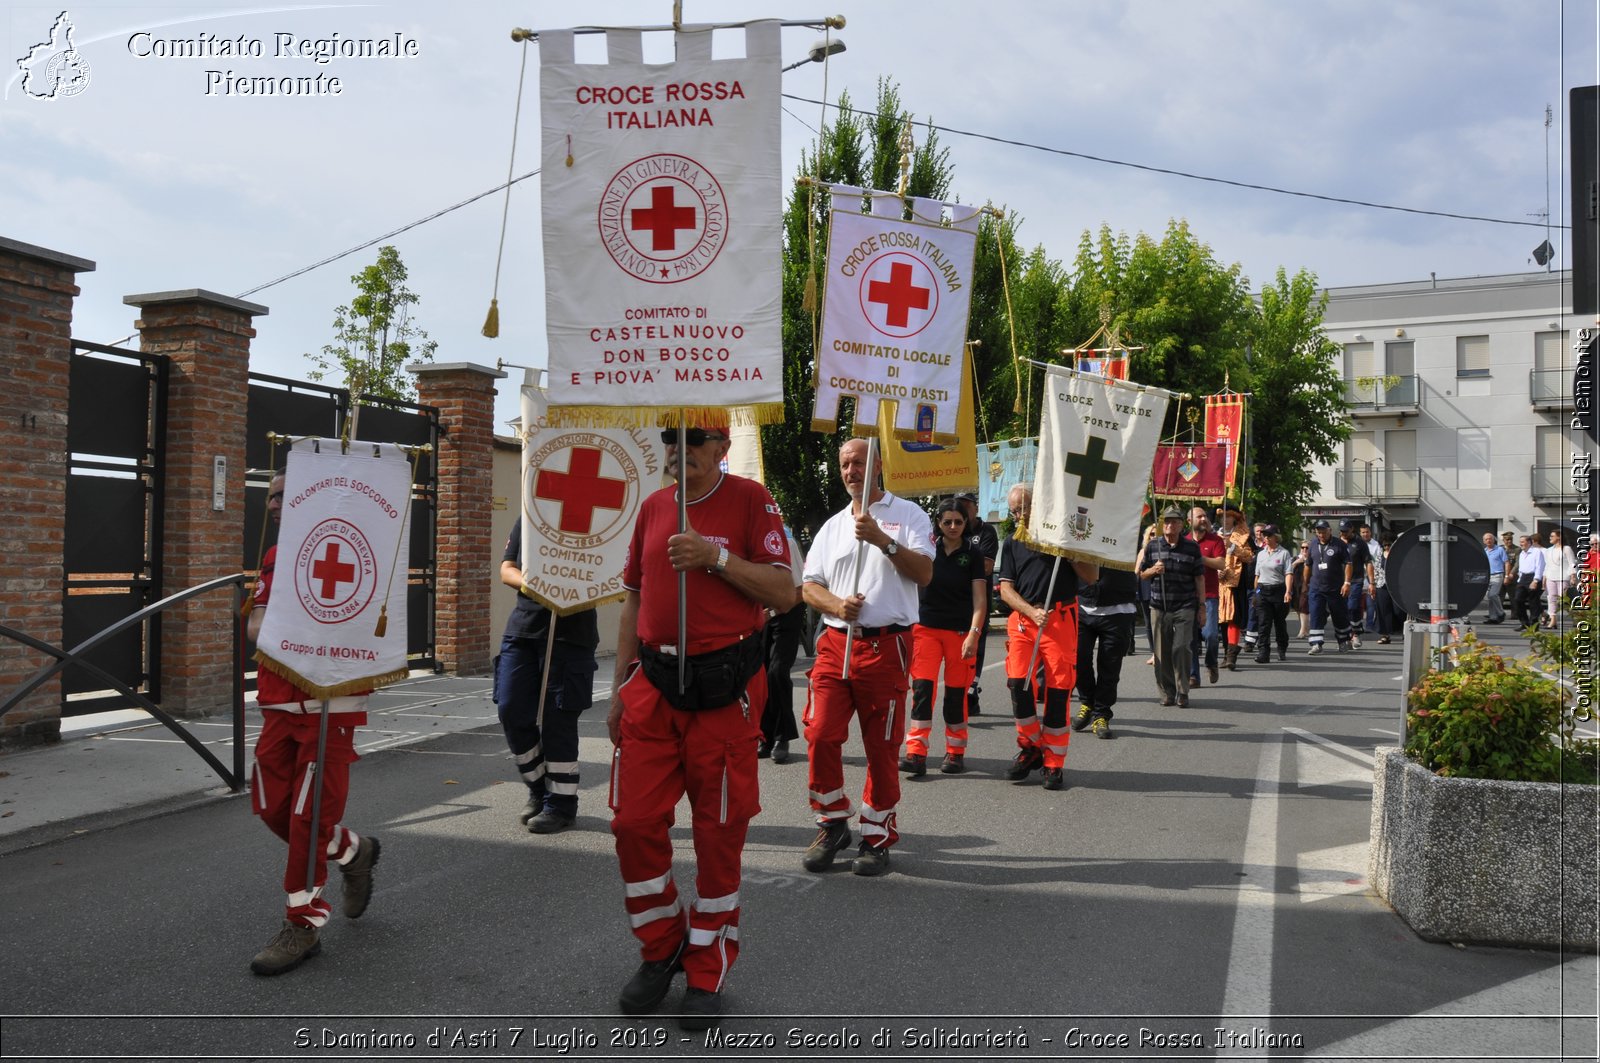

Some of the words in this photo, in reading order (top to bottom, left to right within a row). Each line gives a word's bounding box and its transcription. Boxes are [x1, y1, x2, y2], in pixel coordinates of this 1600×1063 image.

[576, 86, 654, 104] CROCE
[666, 81, 745, 102] ROSSA
[607, 108, 714, 129] ITALIANA
[618, 171, 637, 190] DI
[635, 158, 700, 185] GINEVRA
[698, 182, 717, 200] 22
[602, 186, 656, 278] CONVENZIONE
[697, 202, 723, 258] AGOSTO
[673, 253, 702, 277] 1864
[841, 236, 880, 278] CROCE
[878, 231, 920, 251] ROSSA
[920, 240, 962, 294] ITALIANA
[625, 307, 690, 320] COMITATO
[695, 307, 707, 319] DI
[590, 325, 745, 342] CASTELNUOVO
[603, 349, 645, 364] DON
[659, 347, 730, 362] BOSCO
[833, 339, 900, 360] COMITATO
[903, 349, 952, 366] LOCALE
[571, 372, 581, 385] E
[594, 369, 661, 385] PIOVA'
[675, 367, 763, 382] MASSAIA
[887, 365, 899, 378] DI
[830, 376, 908, 398] COCCONATO
[911, 387, 948, 402] D'ASTI
[1059, 392, 1094, 406] CROCE
[1115, 403, 1152, 418] VERDE
[1084, 416, 1120, 431] PORTE
[530, 434, 596, 468] CONVENZIONE
[598, 438, 609, 448] DI
[610, 444, 638, 484] GINEVRA
[891, 472, 907, 480] SAN
[908, 469, 944, 480] DAMIANO
[289, 478, 333, 508] VOLONTARI
[334, 477, 349, 487] DEL
[350, 479, 398, 519] SOCCORSO
[1042, 521, 1057, 531] 1947
[299, 523, 338, 568] CONVENZIONE
[339, 525, 350, 535] DI
[349, 532, 373, 575] GINEVRA
[1101, 536, 1118, 546] 2012
[539, 545, 604, 566] COMITATO
[542, 563, 594, 582] LOCALE
[309, 603, 340, 618] AGOSTO
[340, 599, 361, 616] 1864
[280, 639, 314, 655] Gruppo
[316, 645, 327, 657] di
[329, 646, 379, 662] MONTA'
